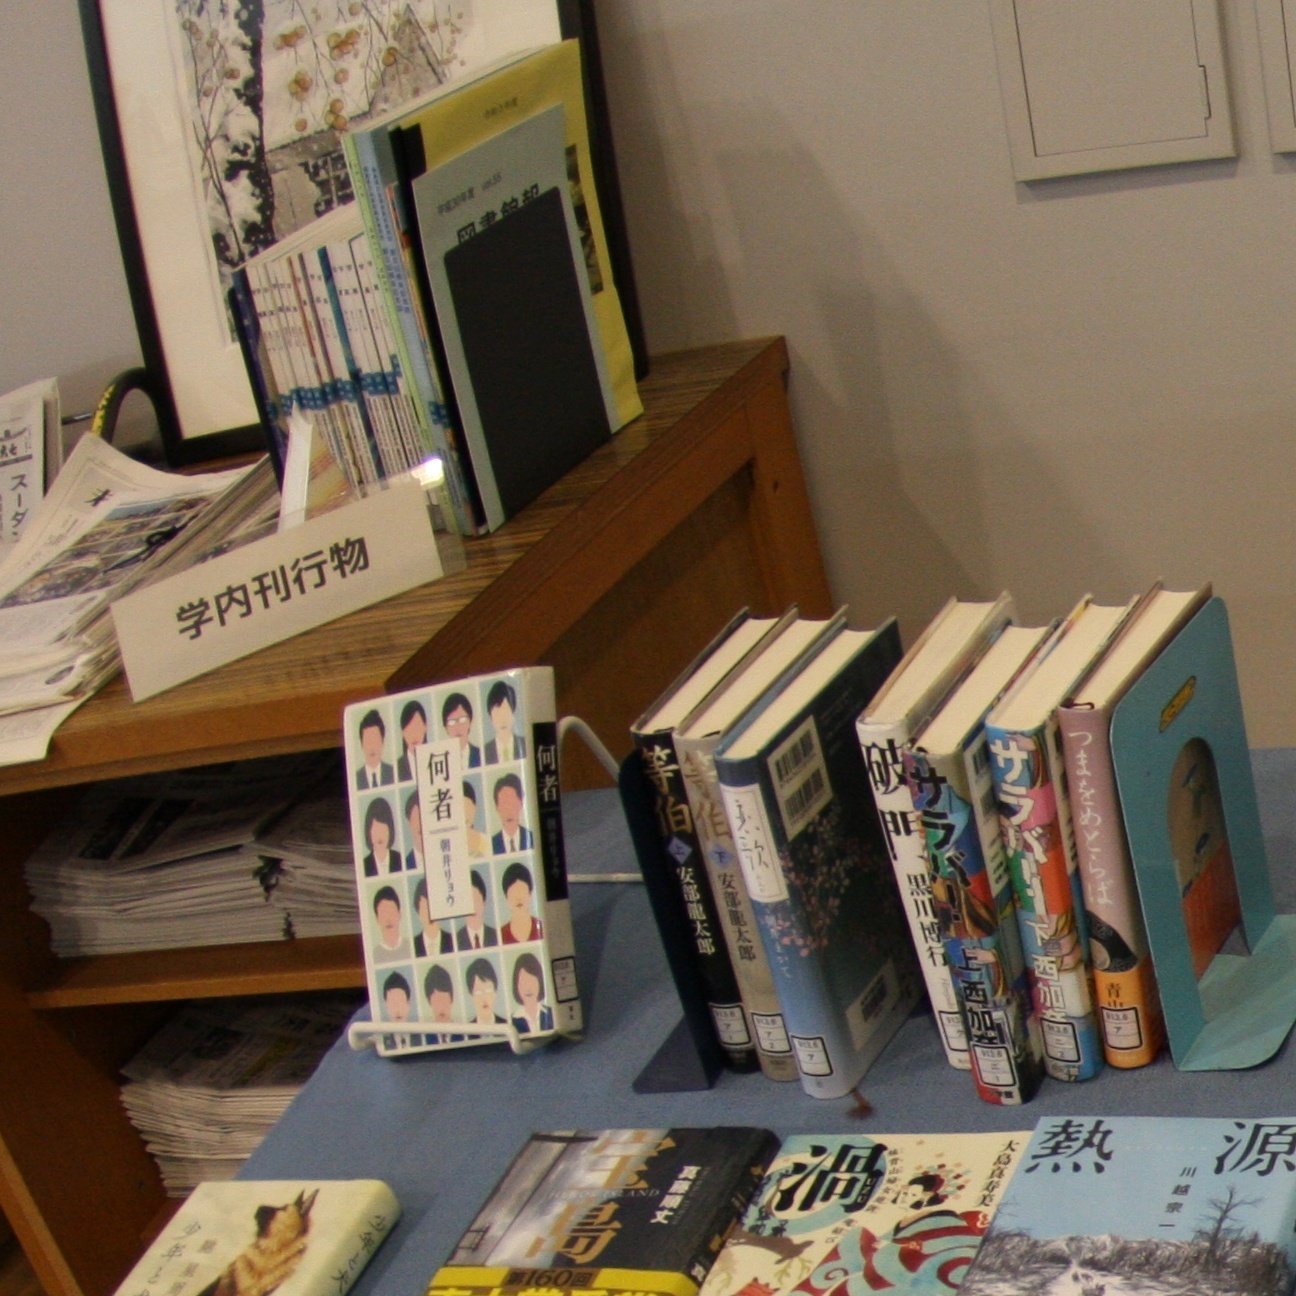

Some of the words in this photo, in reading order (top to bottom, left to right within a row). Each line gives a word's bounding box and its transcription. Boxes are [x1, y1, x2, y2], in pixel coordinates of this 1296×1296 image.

[175, 534, 371, 641] 学内刊行物
[427, 750, 452, 822] 何者
[537, 743, 559, 804] 何者
[864, 738, 919, 860] 破門
[991, 739, 1049, 917] サラバ!
[439, 837, 457, 908] 朝井リョウ
[677, 867, 716, 955] 安部龍太郎
[718, 873, 757, 962] 安部龍太郎
[906, 872, 947, 967] 黒川博行
[774, 1142, 888, 1214] 渦
[1158, 1166, 1197, 1228] 川越宗一
[506, 1270, 594, 1288] 第160回
